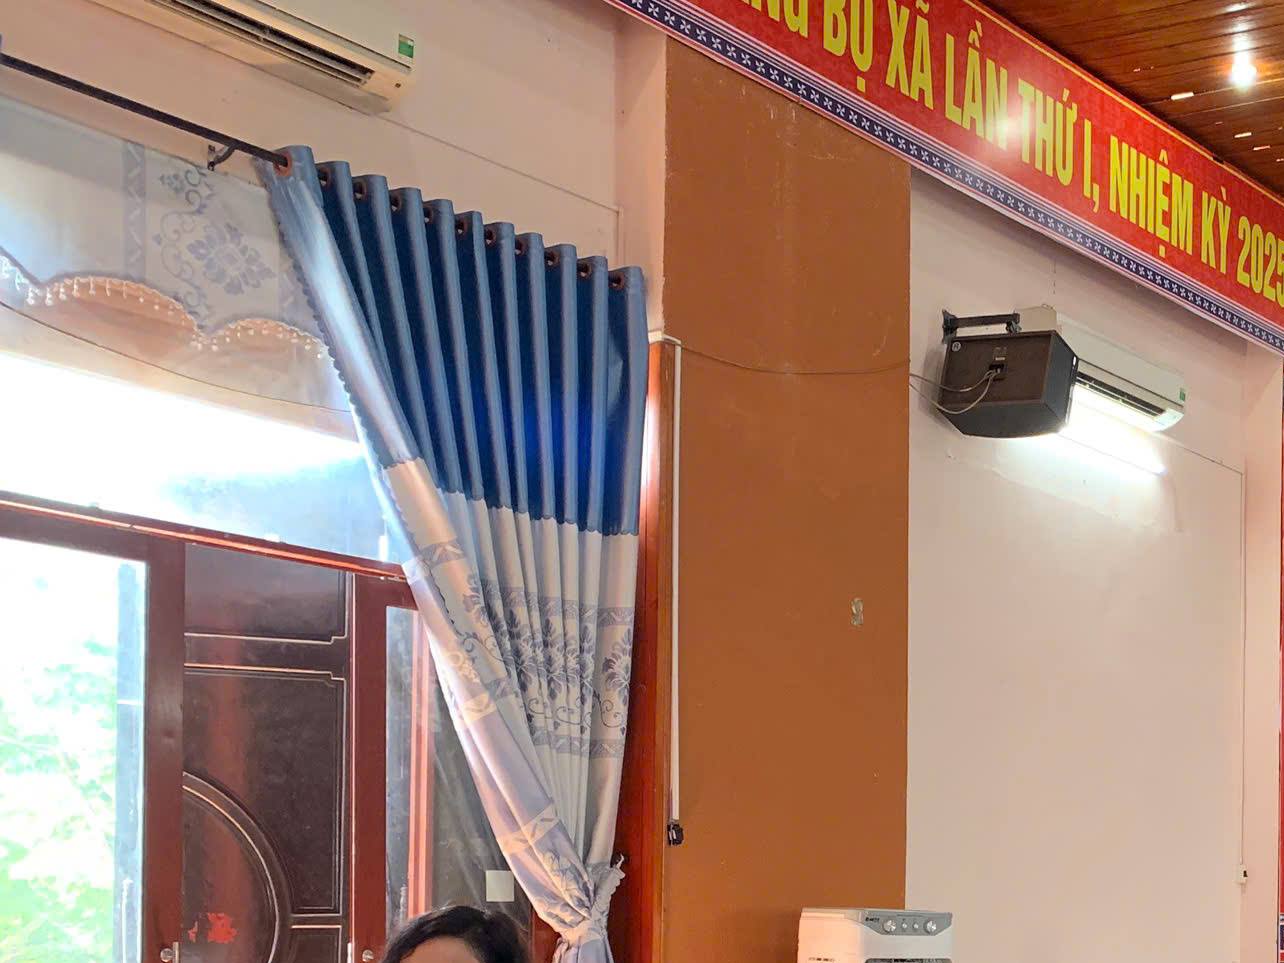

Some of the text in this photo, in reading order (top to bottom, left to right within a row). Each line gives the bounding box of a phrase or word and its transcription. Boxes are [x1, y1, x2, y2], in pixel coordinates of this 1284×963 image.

[886, 0, 934, 110] XÃ
[945, 20, 1009, 151] LẦN
[1017, 87, 1078, 187] THỨ
[1083, 118, 1100, 213] I,
[1109, 134, 1194, 259] NHIỆM
[1201, 186, 1232, 275] KỲ
